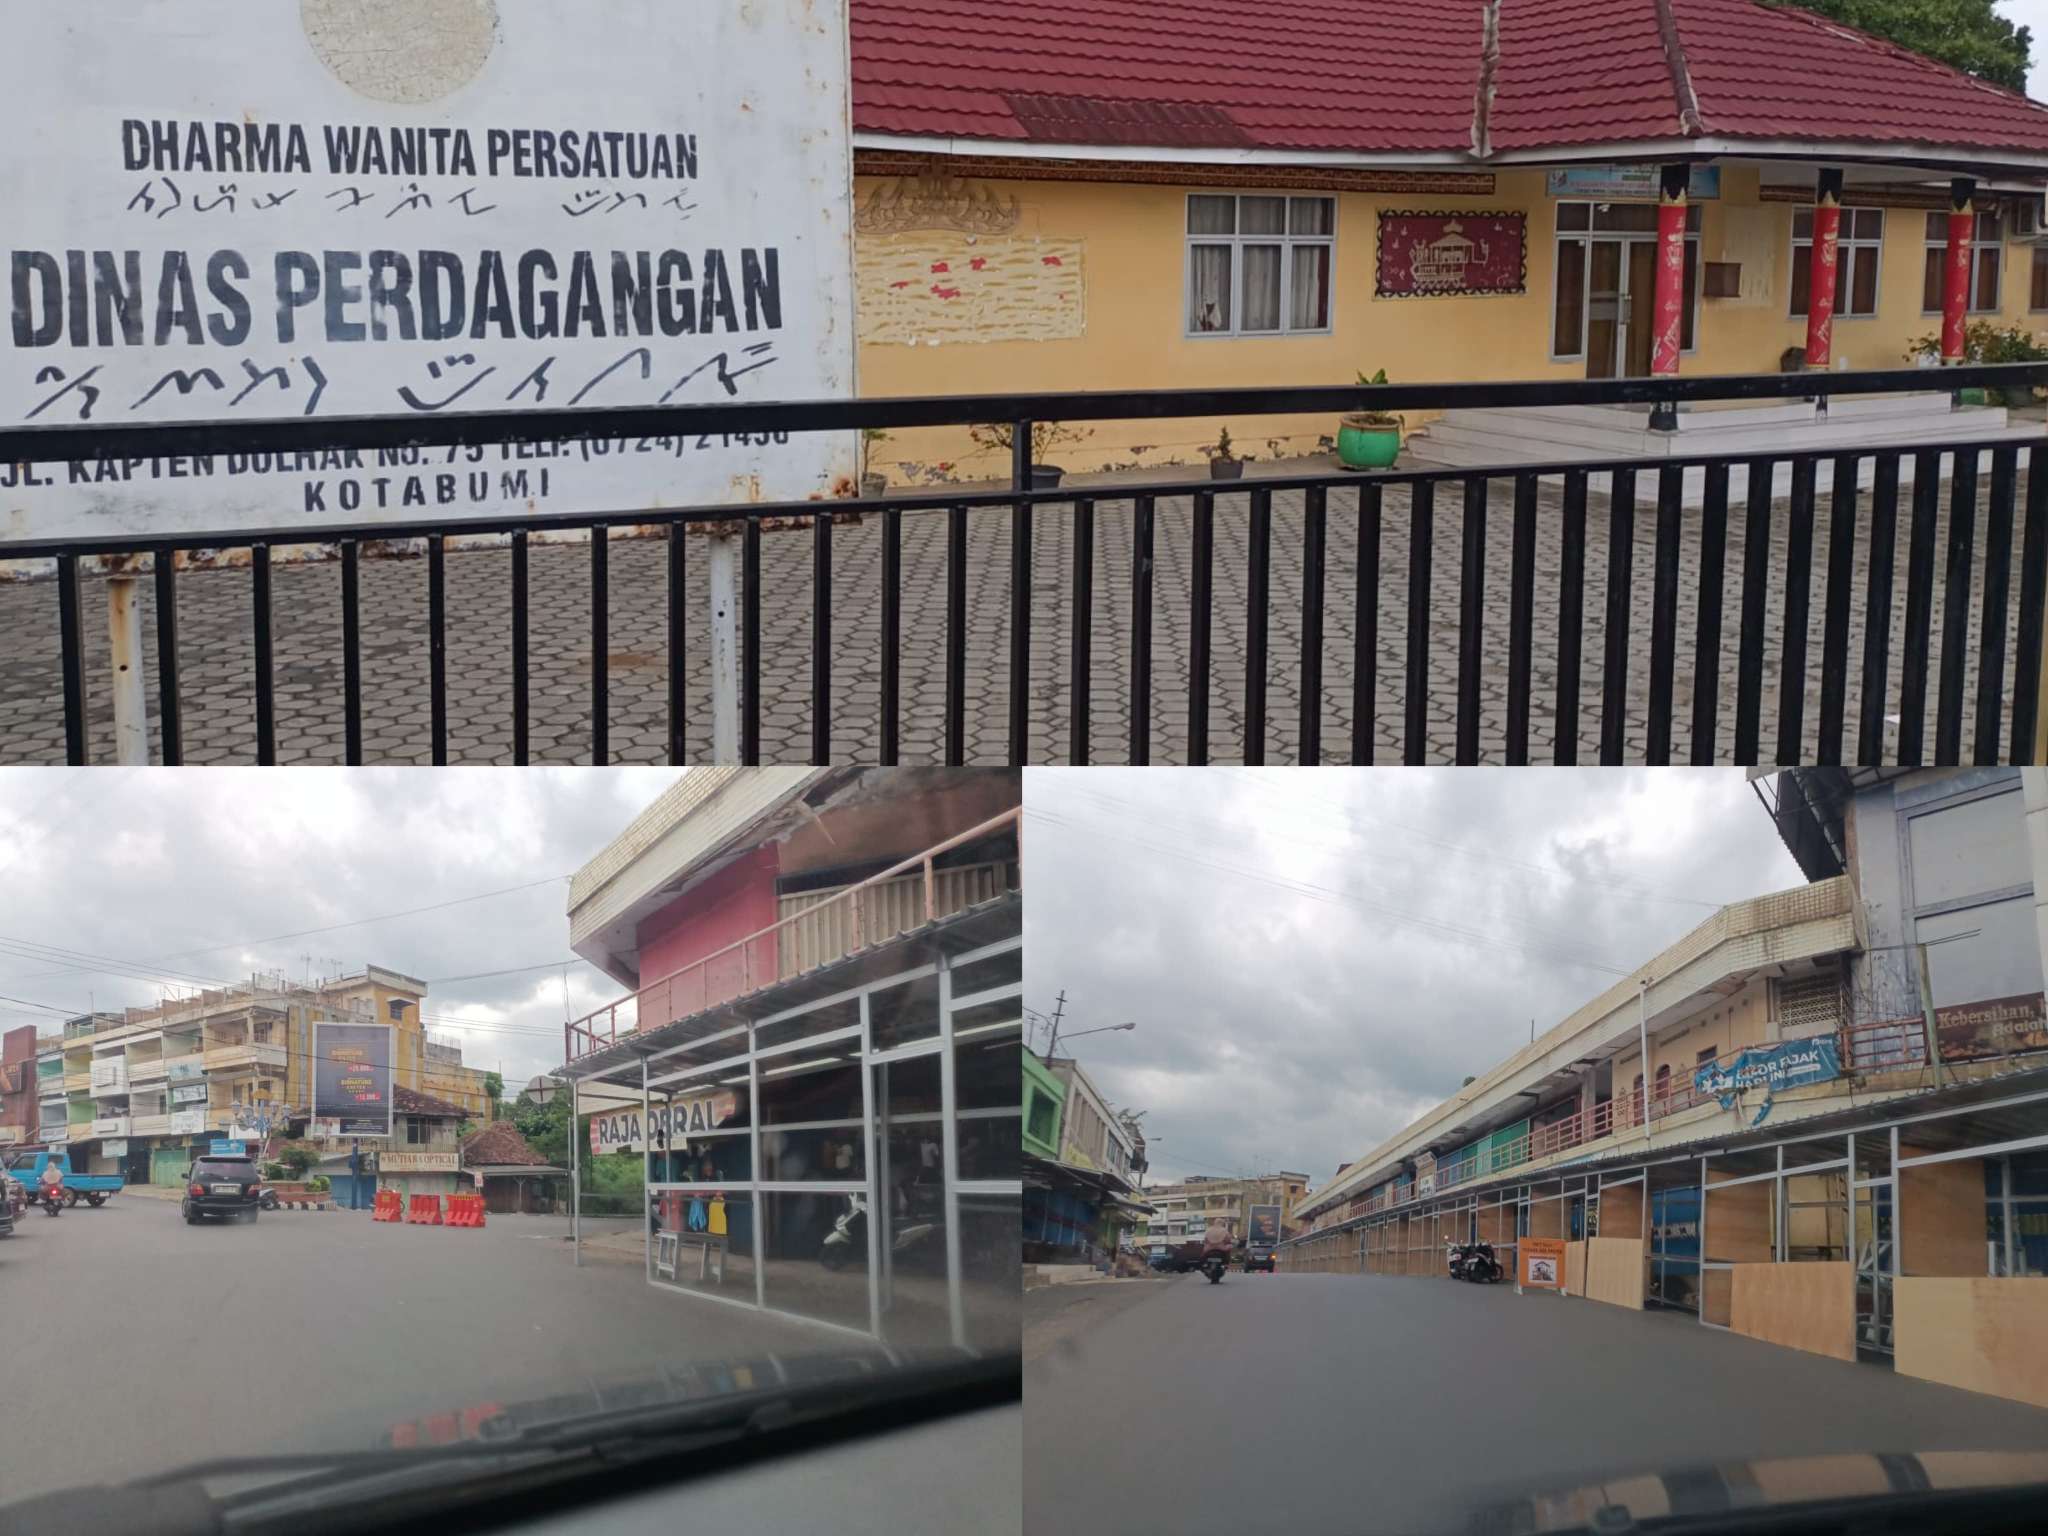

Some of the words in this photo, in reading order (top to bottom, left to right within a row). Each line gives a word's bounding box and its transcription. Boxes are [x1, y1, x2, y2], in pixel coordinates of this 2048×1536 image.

[122, 120, 311, 173] DHARMA
[324, 125, 476, 176] WANITA
[487, 129, 698, 179] PERSATUAN
[11, 249, 252, 347] DINAS
[275, 248, 782, 341] PERDAGANGAN
[0, 461, 53, 487] JL.
[304, 468, 548, 512] KOTABUMI
[600, 1113, 642, 1144] RAJA
